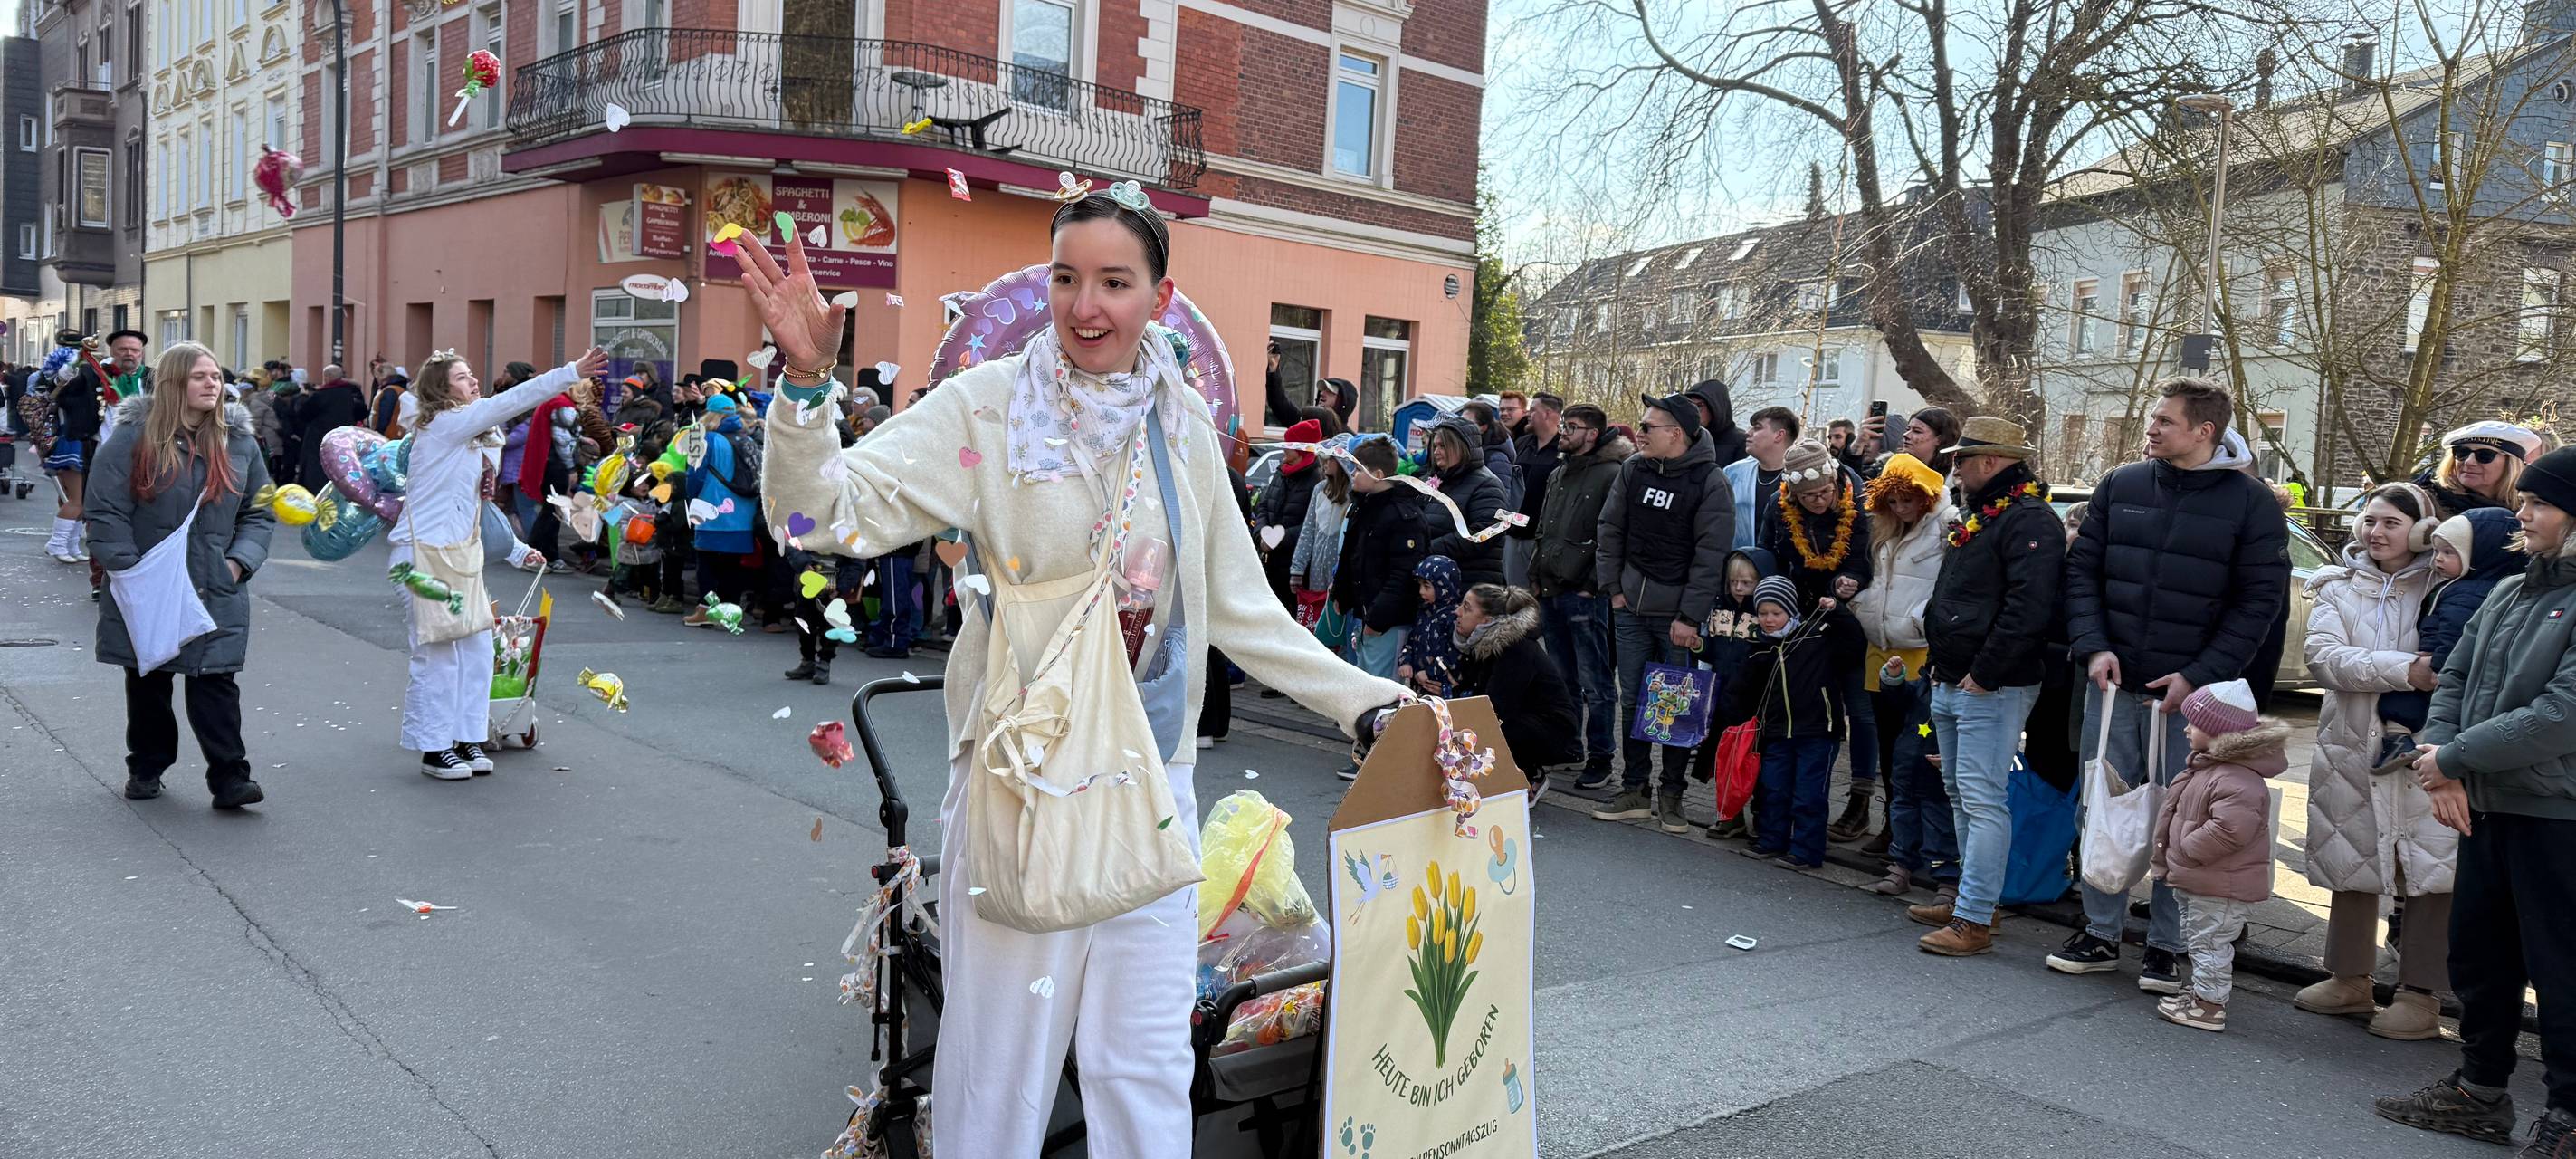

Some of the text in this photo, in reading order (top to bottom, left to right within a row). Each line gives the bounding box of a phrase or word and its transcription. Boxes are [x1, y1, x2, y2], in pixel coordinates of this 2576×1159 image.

[775, 187, 830, 198] SPAGHETTI
[797, 199, 807, 209] &
[773, 210, 831, 223] MBERONI
[822, 256, 844, 264] Carne
[849, 258, 872, 266] Pesce
[877, 260, 893, 268] Vino
[810, 268, 841, 277] yservice
[1643, 487, 1674, 509] FBI
[1371, 1003, 1499, 1107] HEUTE BIN ICH GEBOREN
[1410, 1119, 1498, 1159] PENSONNTAGSZUG
